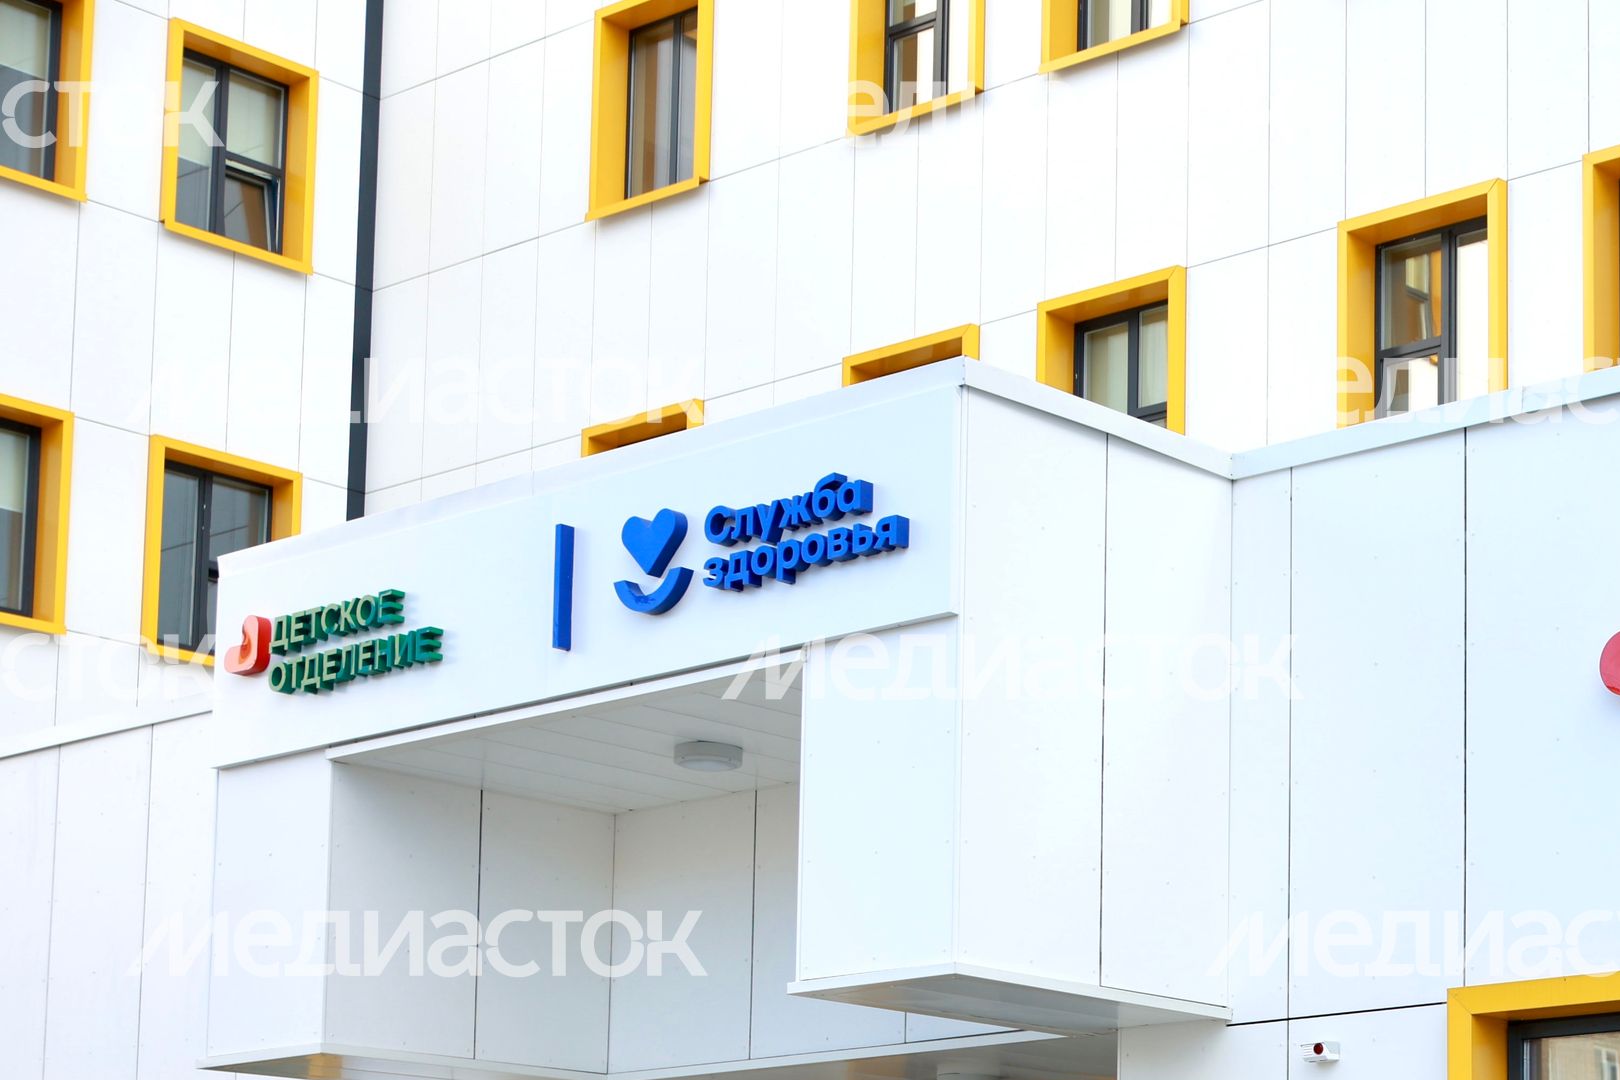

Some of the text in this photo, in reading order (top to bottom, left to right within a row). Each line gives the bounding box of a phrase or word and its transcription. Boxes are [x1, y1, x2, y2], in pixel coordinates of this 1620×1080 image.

[703, 472, 874, 546] Служба
[702, 514, 910, 592] здоровья
[269, 588, 406, 656] ДЕТСКОЕ
[268, 625, 445, 695] ОТДЕЛЕНИЕ
